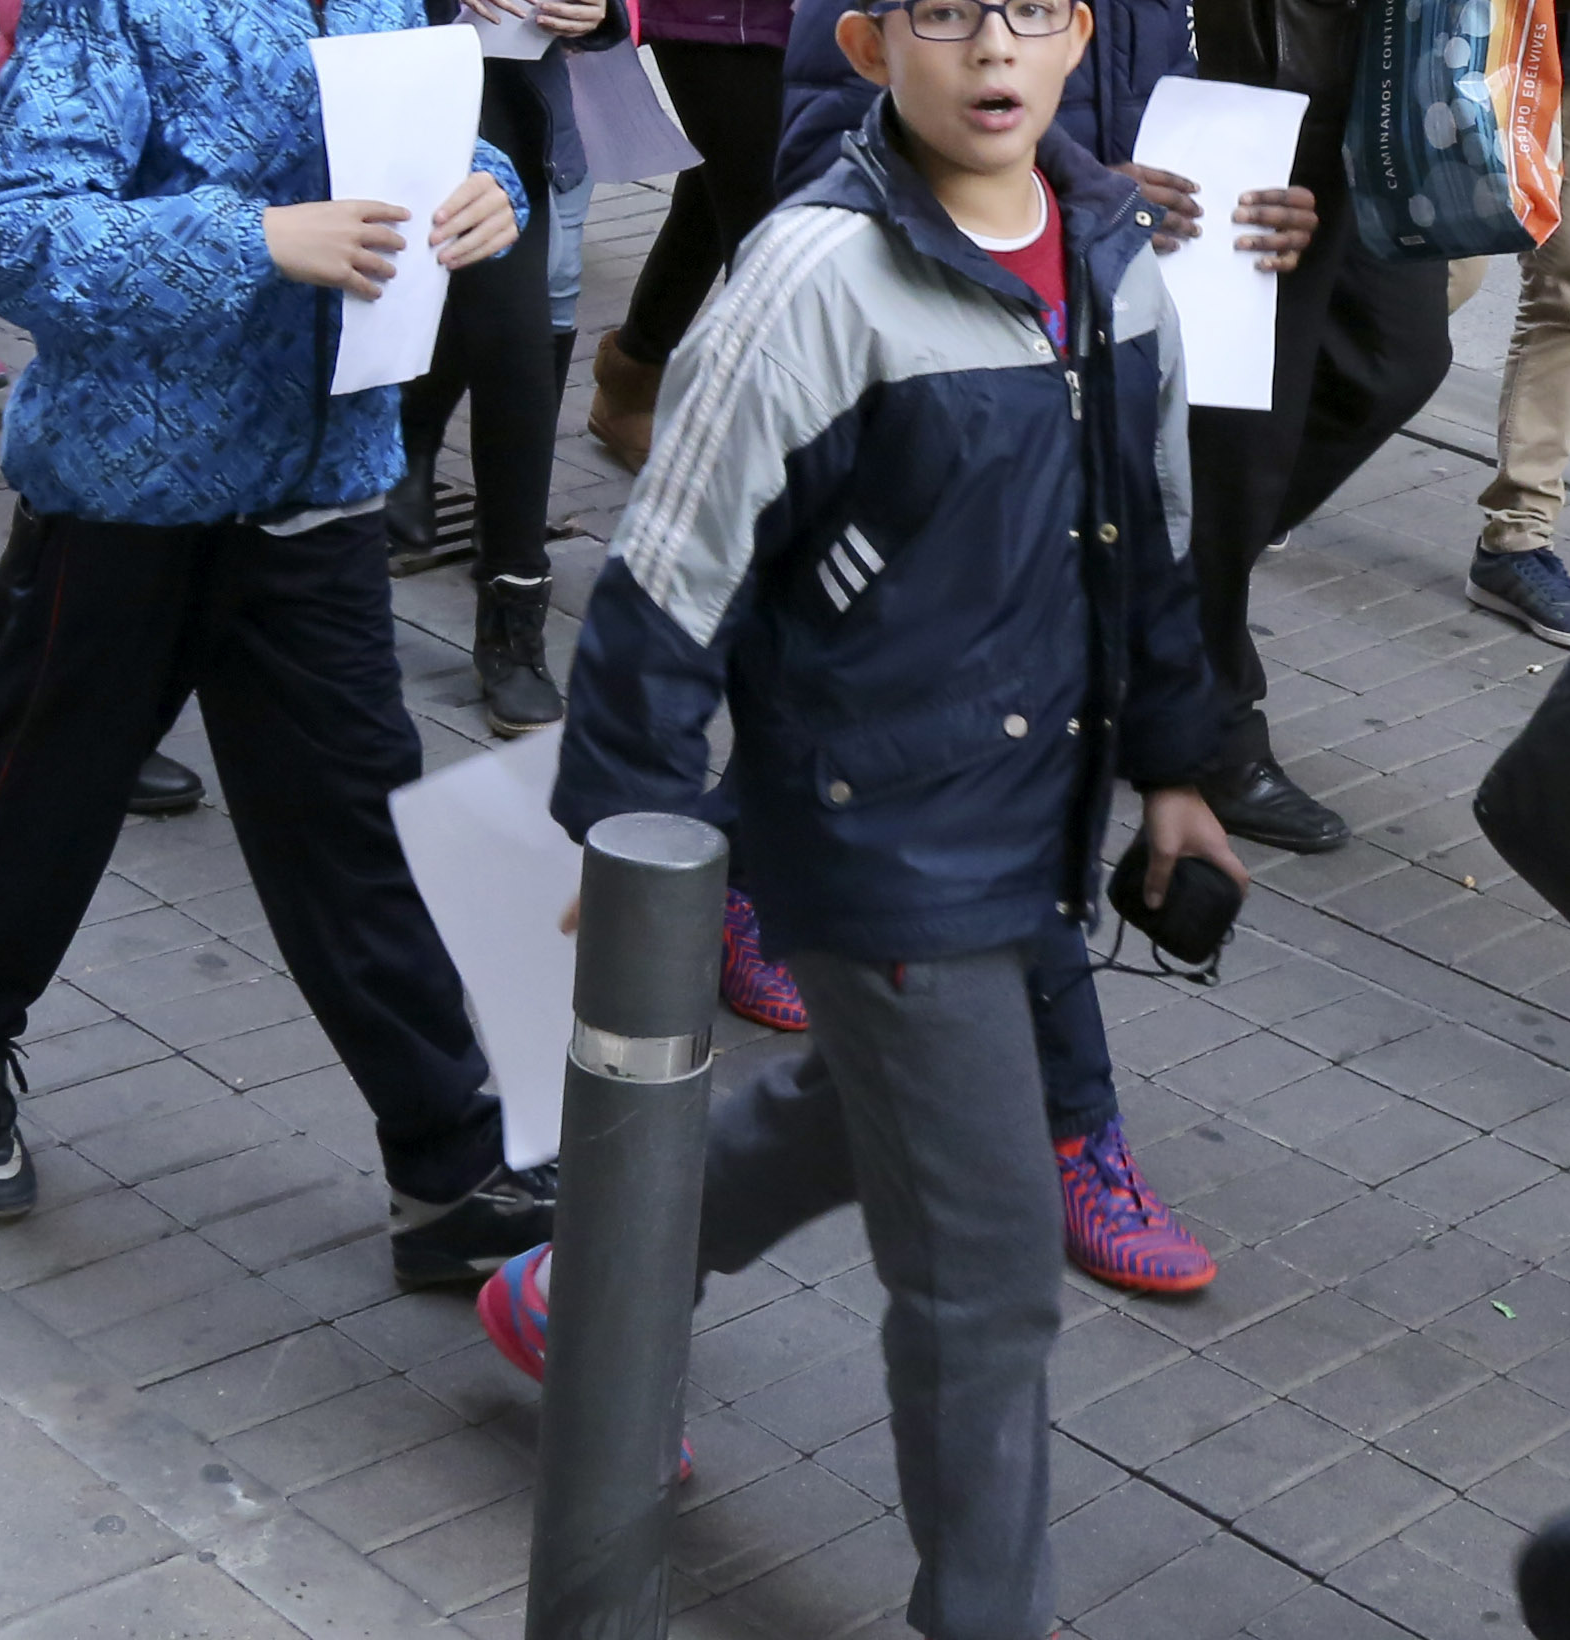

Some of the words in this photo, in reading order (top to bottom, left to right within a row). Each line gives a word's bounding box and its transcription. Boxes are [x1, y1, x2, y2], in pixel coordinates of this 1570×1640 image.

[1522, 22, 1548, 98] EDELVIVES
[1379, 78, 1398, 190] CAMINAMOS
[1516, 105, 1532, 154] GRUPO
